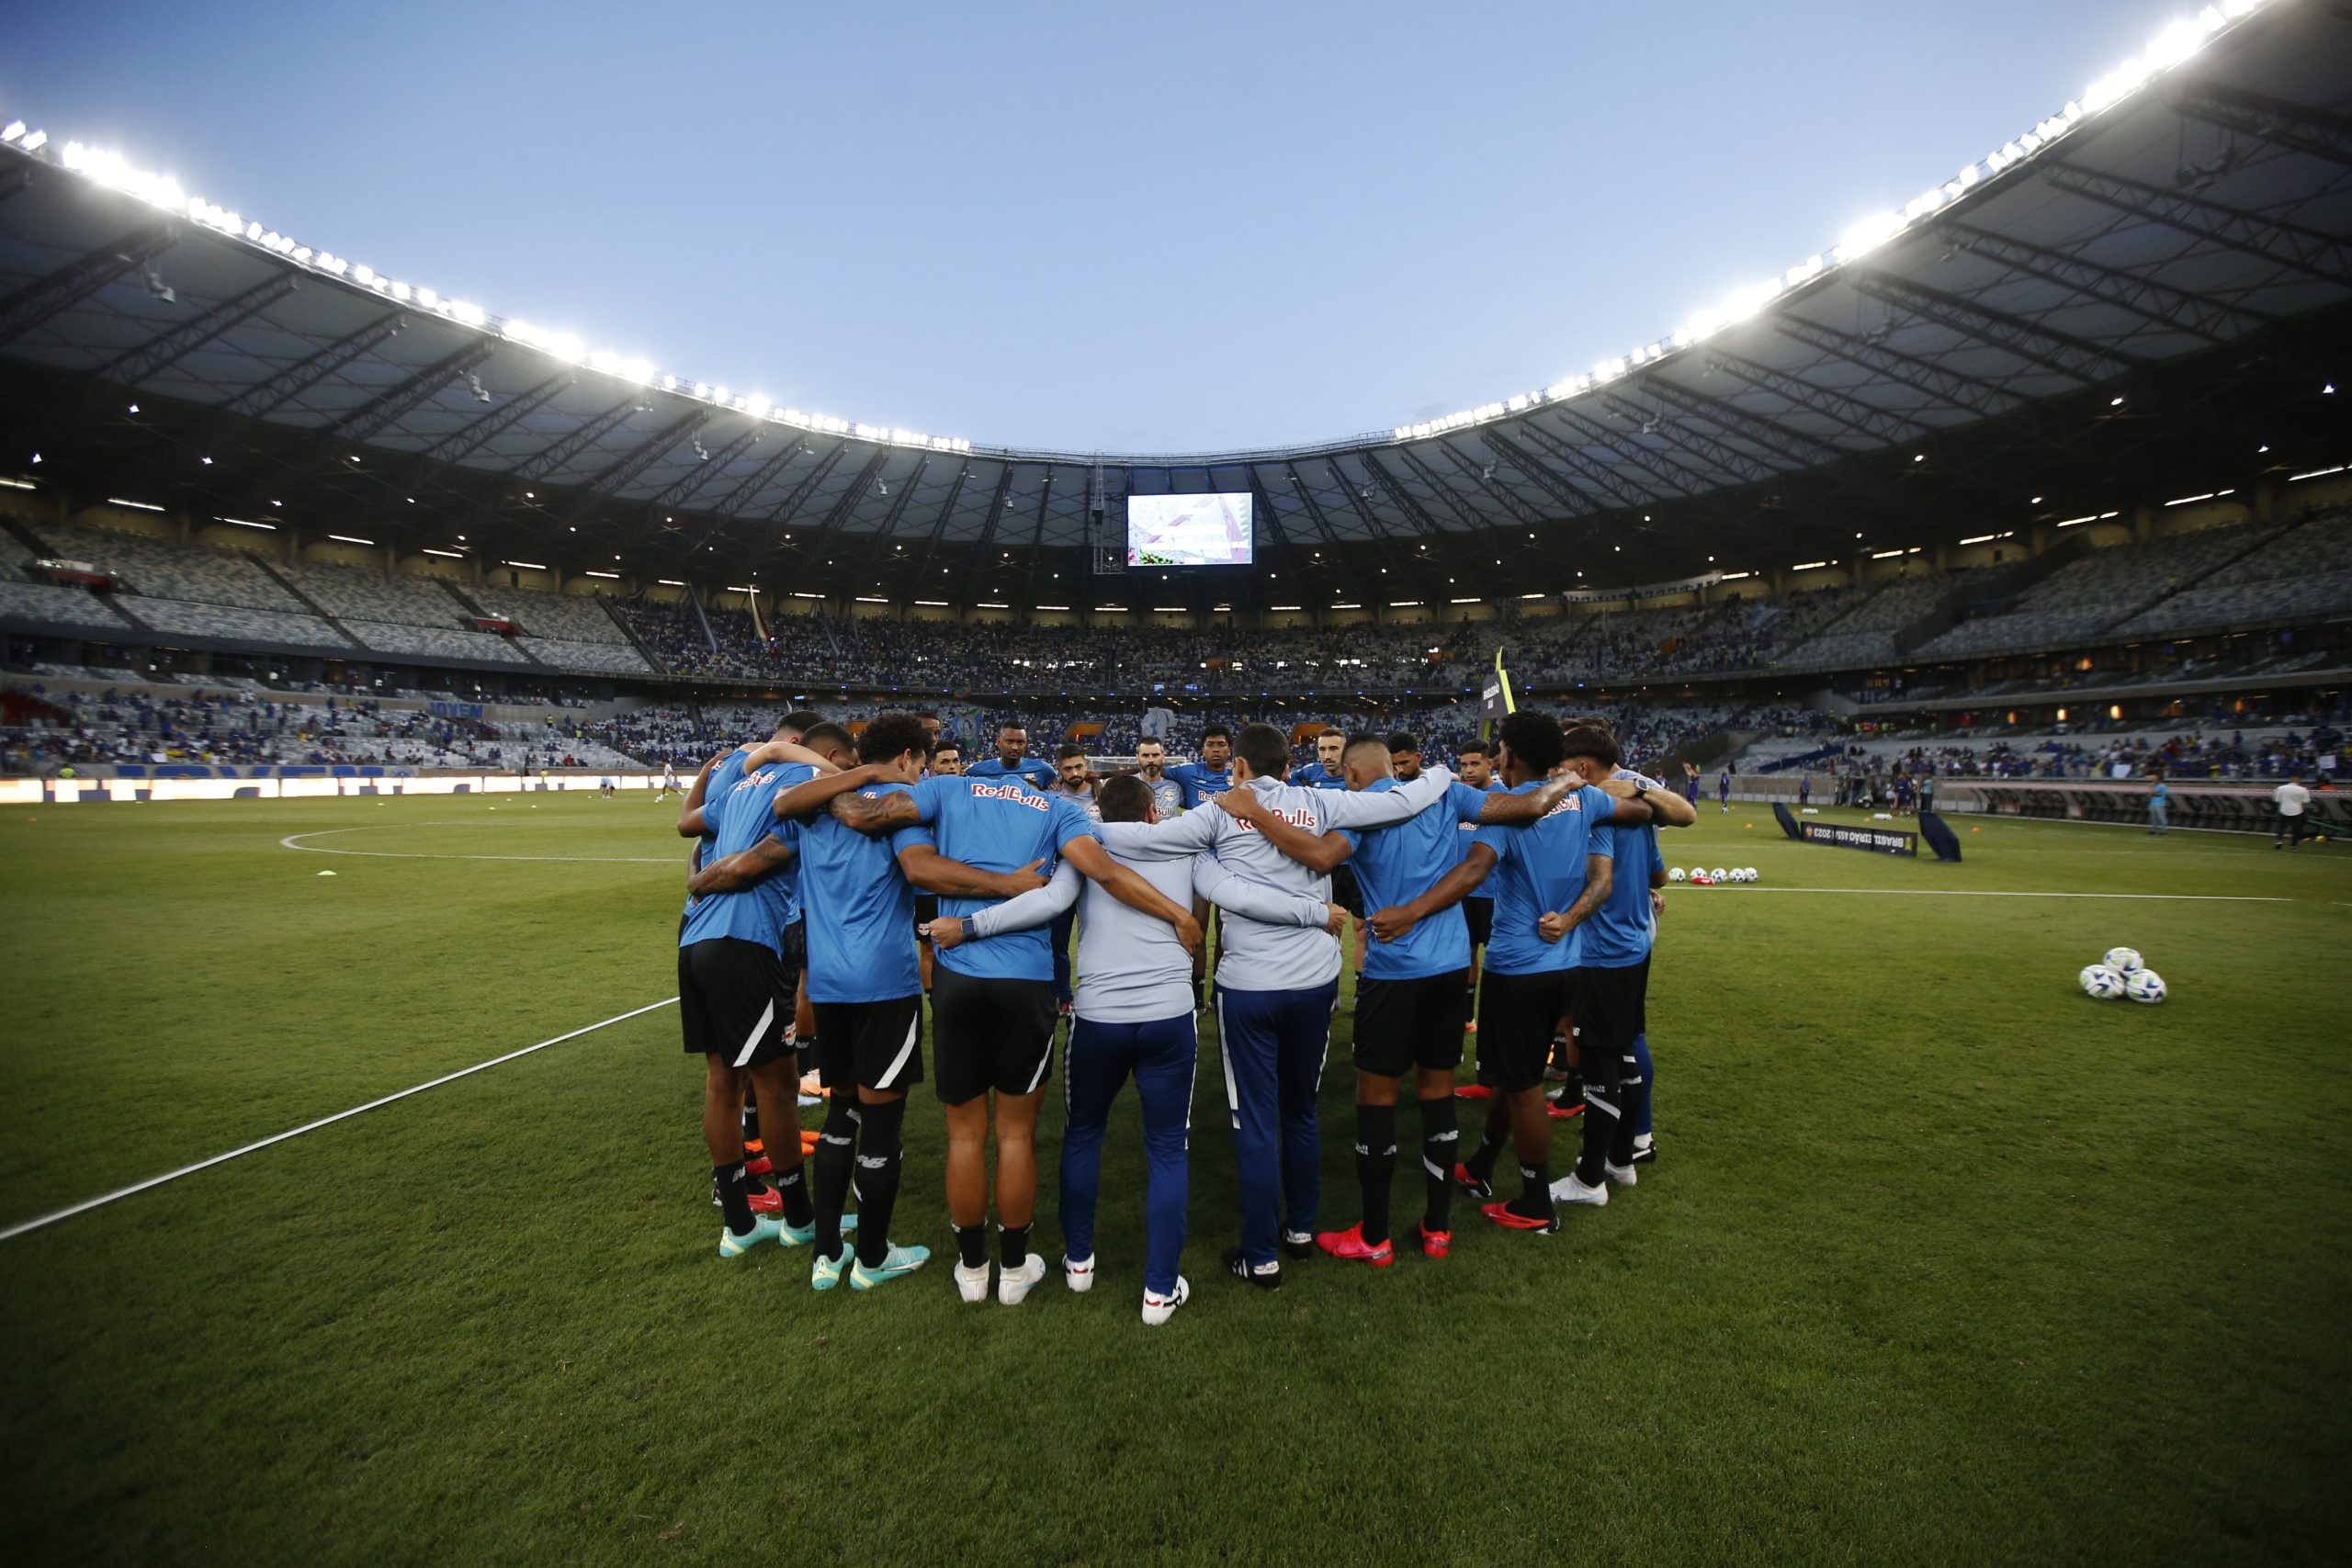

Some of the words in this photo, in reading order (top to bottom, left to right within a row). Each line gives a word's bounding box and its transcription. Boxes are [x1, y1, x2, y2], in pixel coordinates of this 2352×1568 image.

[971, 784, 1009, 799] Red
[1198, 791, 1219, 801] Red
[1814, 828, 1831, 838] 2023
